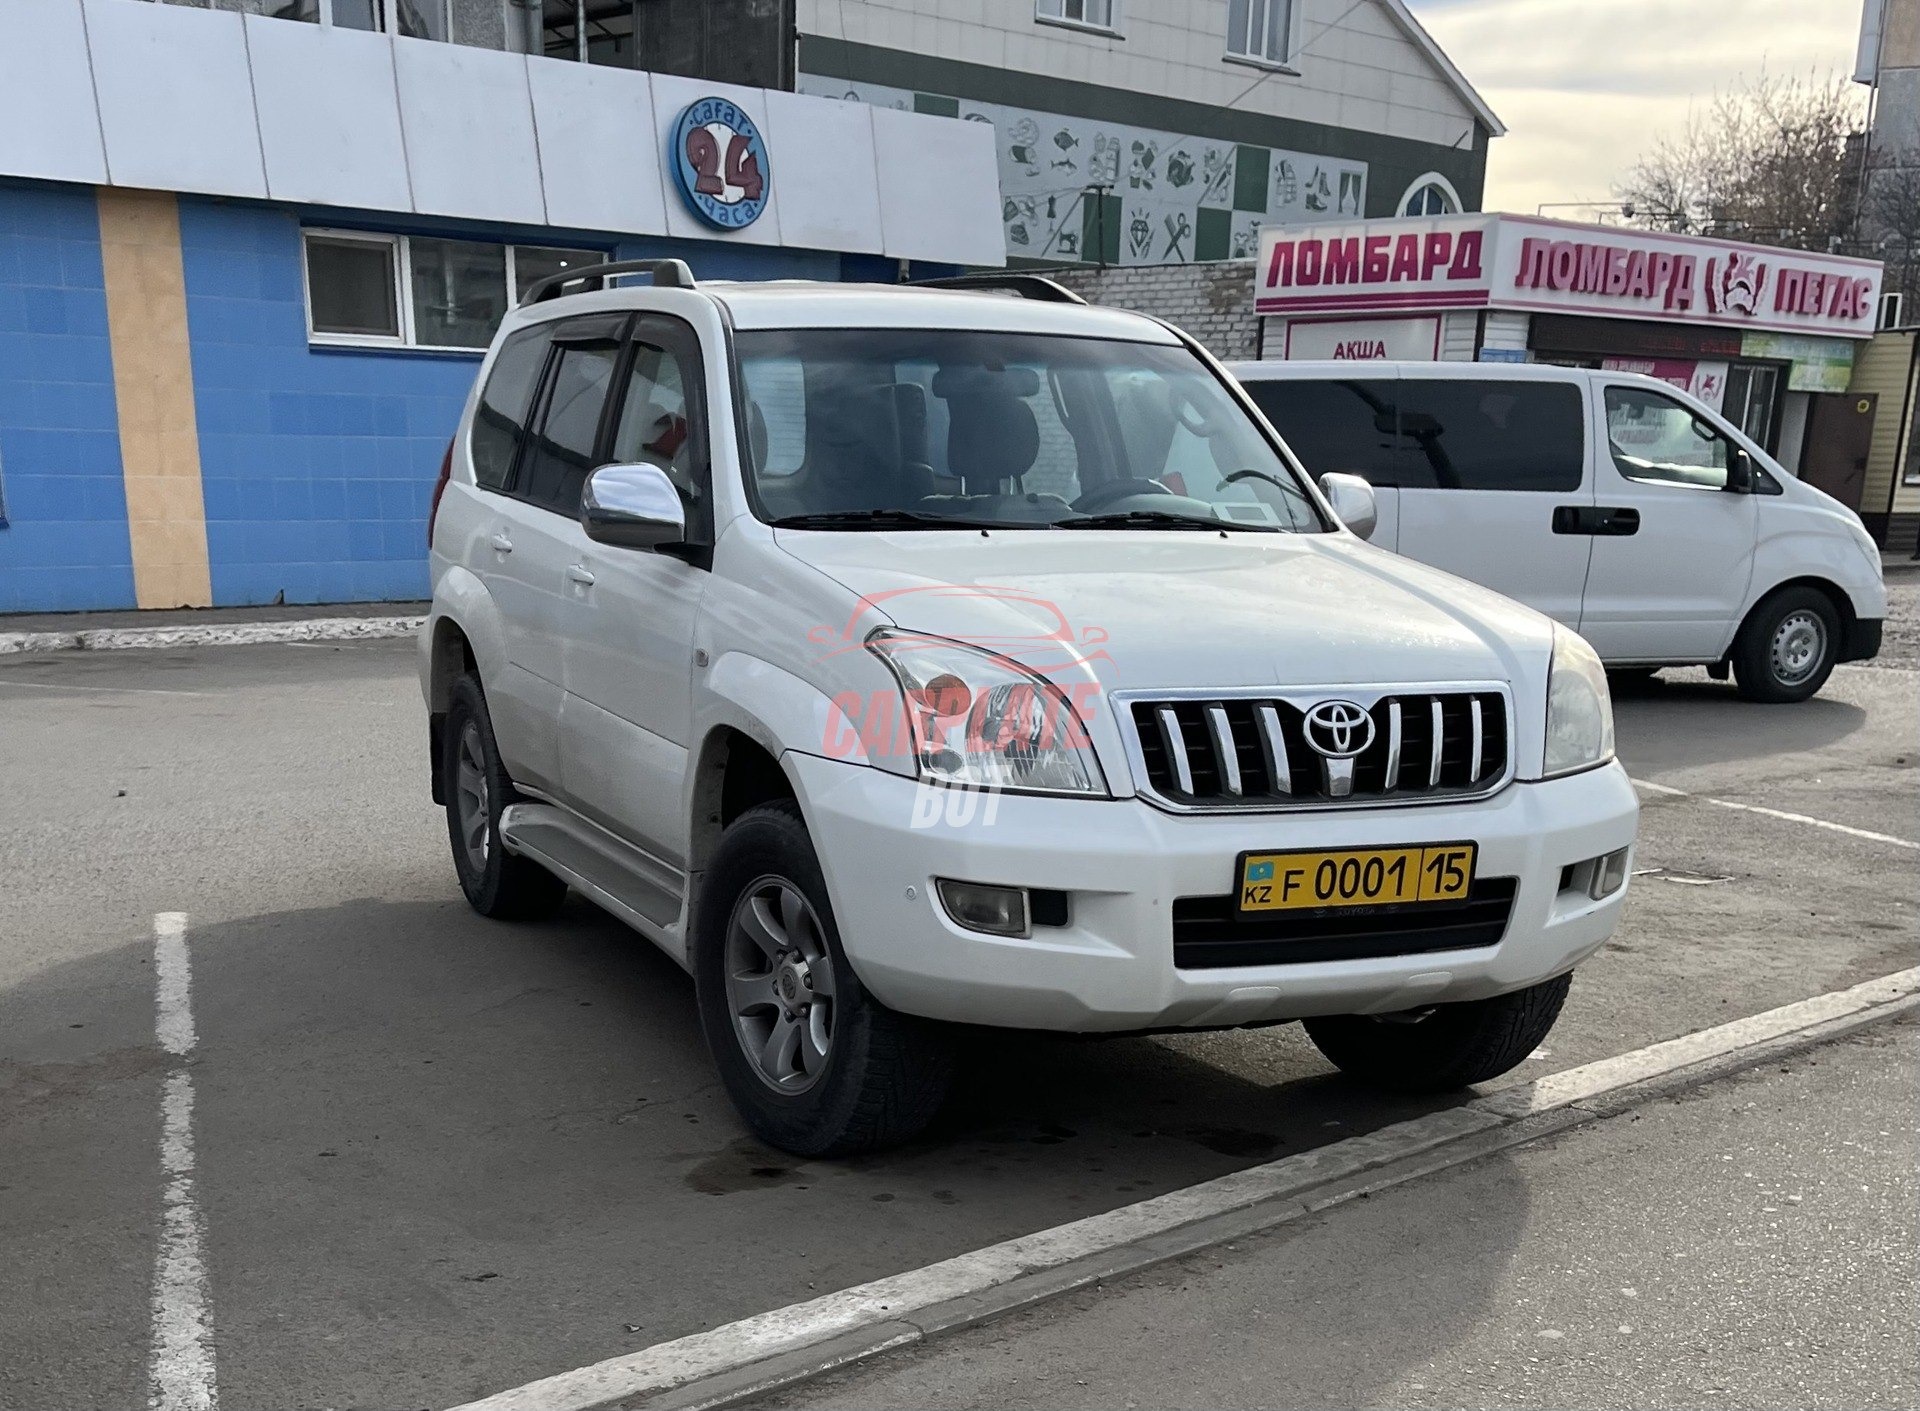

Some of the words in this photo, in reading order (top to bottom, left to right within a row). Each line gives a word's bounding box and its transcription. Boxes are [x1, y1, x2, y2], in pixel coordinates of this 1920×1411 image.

[685, 126, 764, 200] 24
[704, 201, 756, 225] часа
[1266, 230, 1483, 287] ЛОМБАРД
[1514, 236, 1697, 311] ЛОМБАРД
[1773, 267, 1873, 320] ПЕГАС
[1243, 885, 1273, 905] KZ
[1282, 869, 1305, 903] F
[1314, 855, 1407, 901] 0001
[1426, 851, 1467, 894] 15
